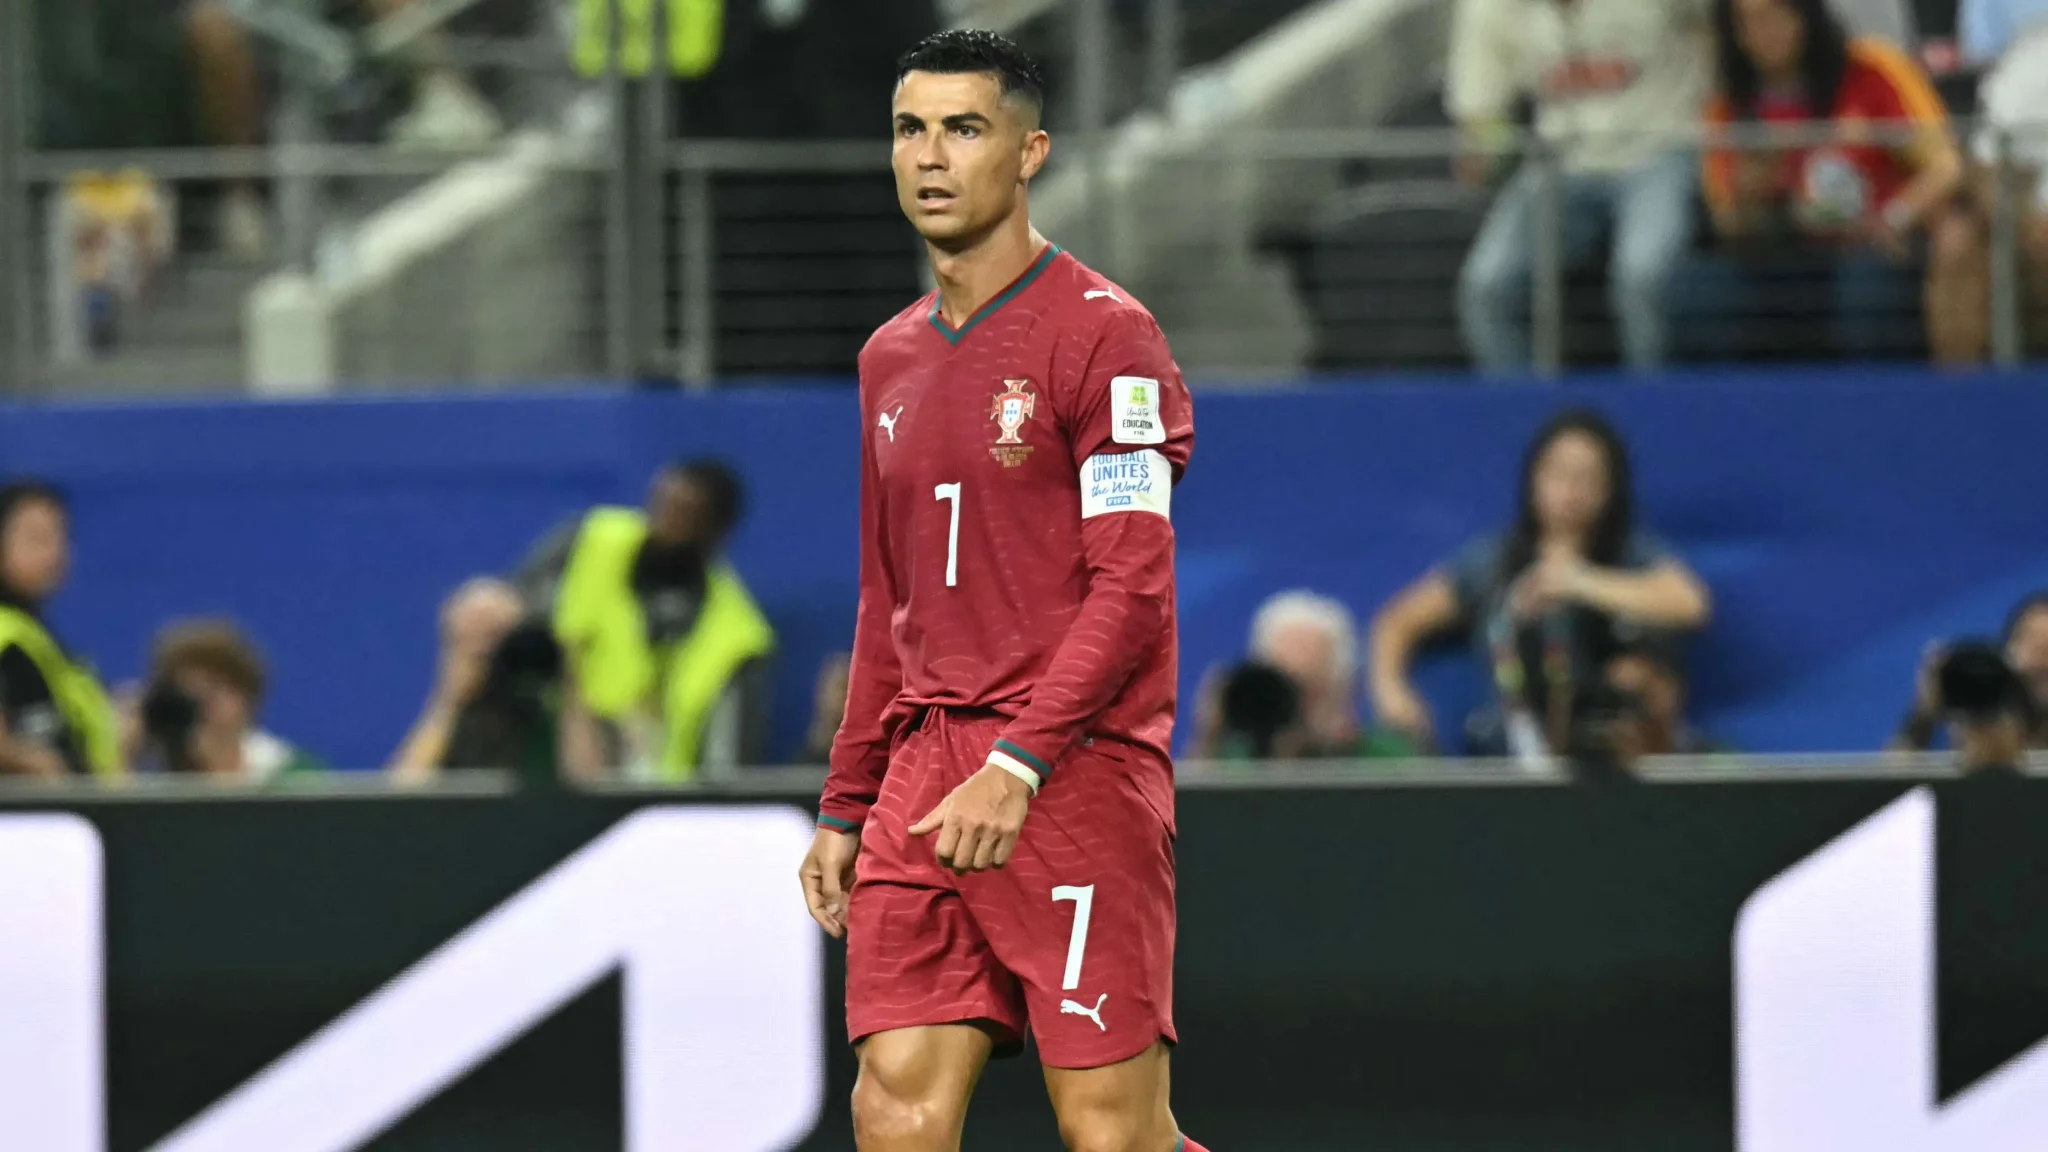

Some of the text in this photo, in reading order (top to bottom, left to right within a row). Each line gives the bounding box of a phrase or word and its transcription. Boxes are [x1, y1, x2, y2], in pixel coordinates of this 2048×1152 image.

[1122, 419, 1153, 429] EDUCATION
[1092, 463, 1149, 482] UNITES
[1092, 479, 1152, 498] the World
[934, 482, 961, 587] 7
[1051, 884, 1095, 990] 7
